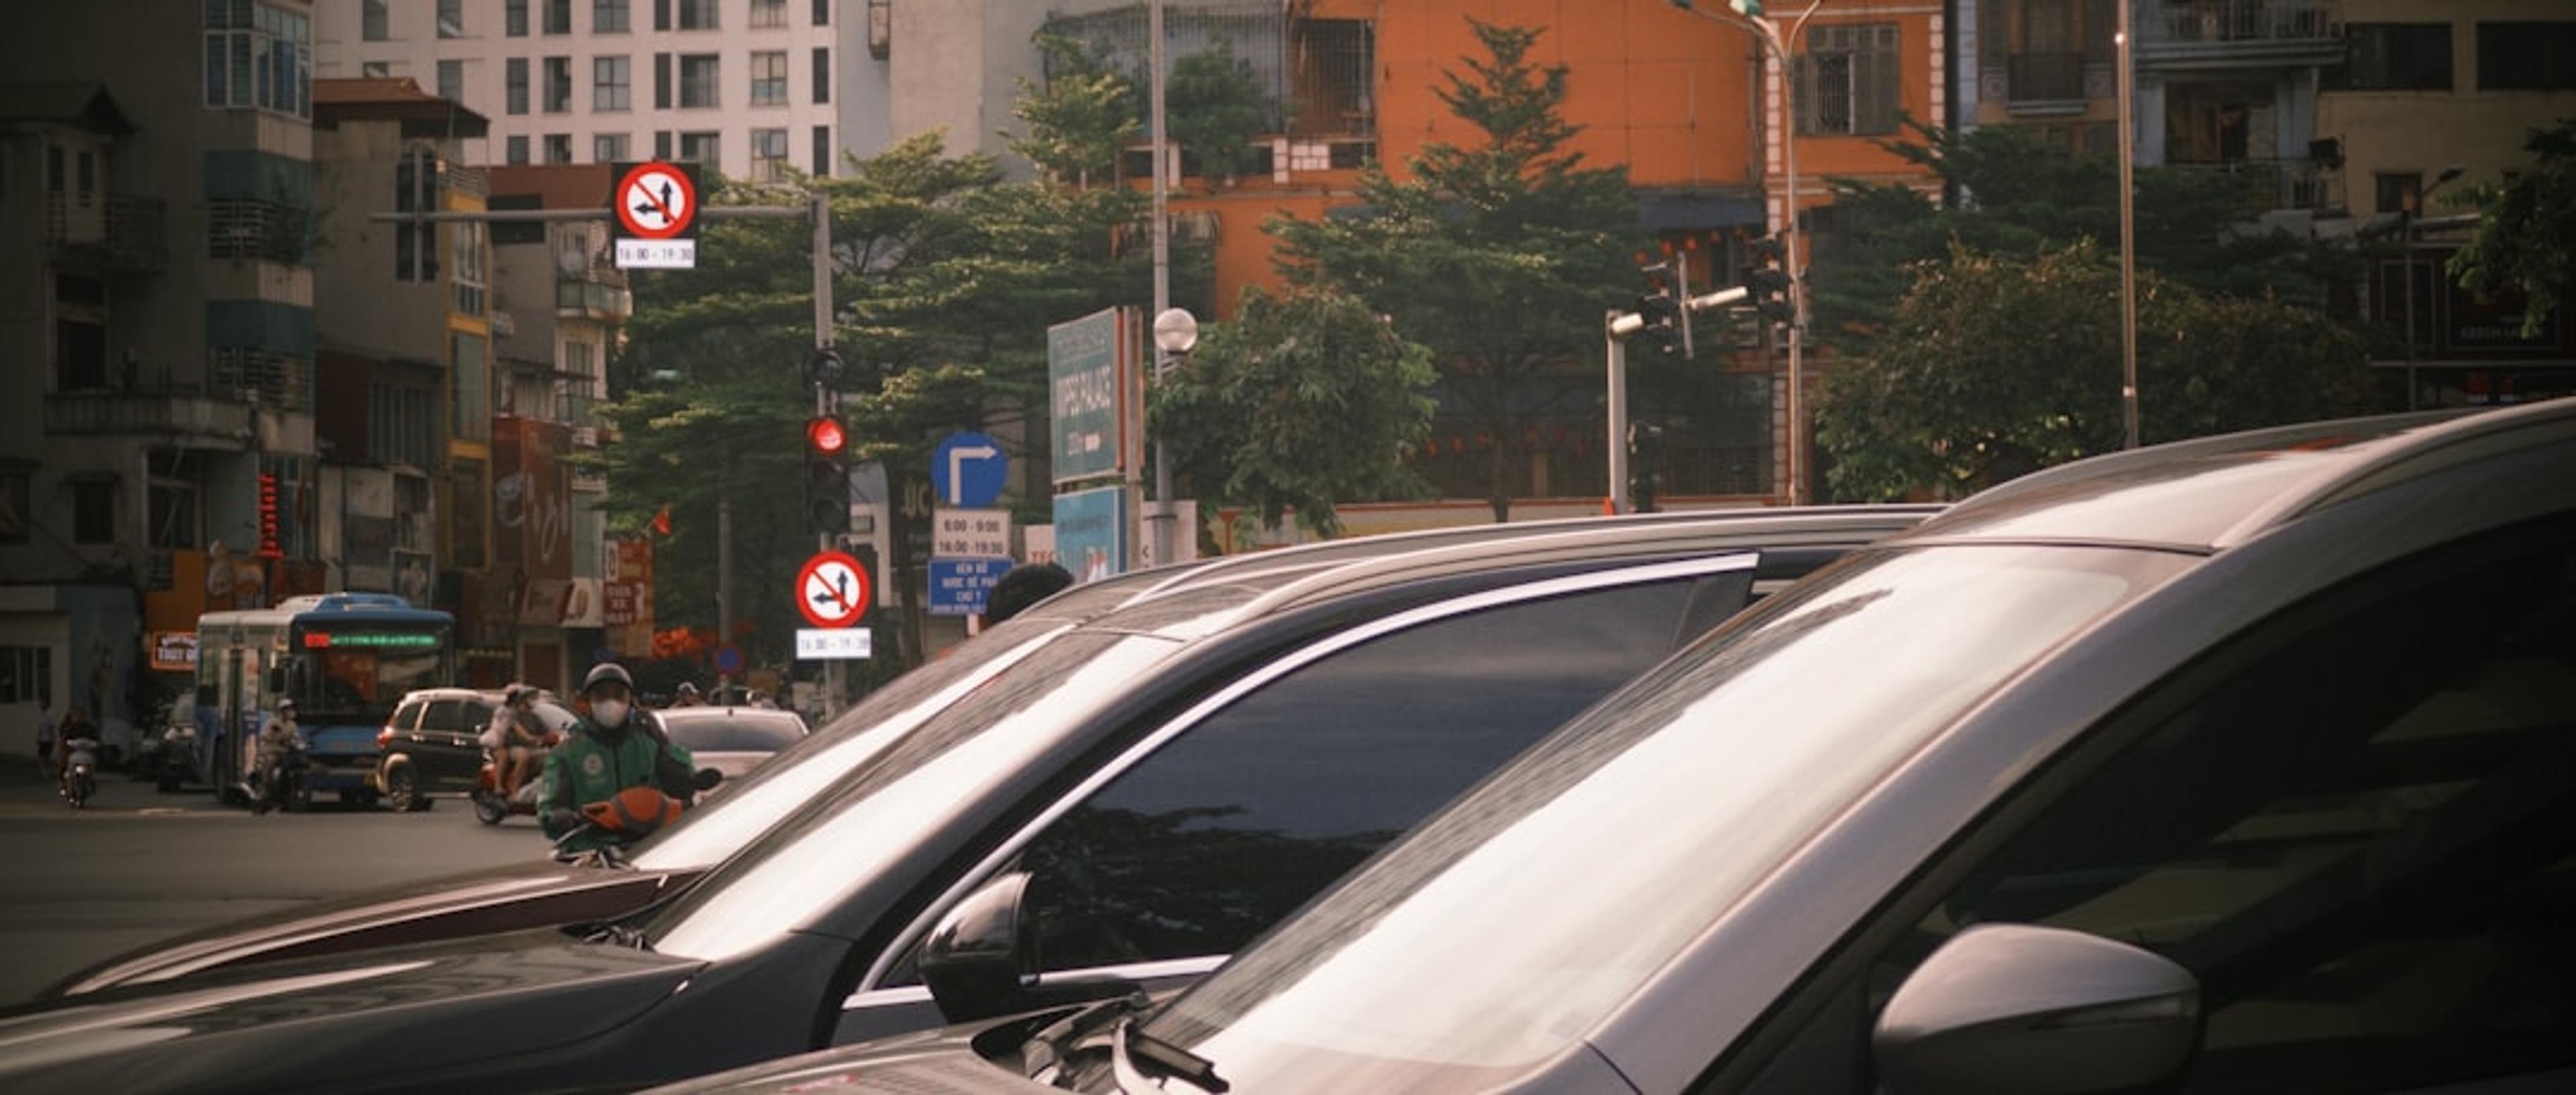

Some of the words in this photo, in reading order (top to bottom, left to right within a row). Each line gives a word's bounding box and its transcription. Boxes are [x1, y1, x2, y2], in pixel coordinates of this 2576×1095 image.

[944, 519, 967, 533] 6:00
[976, 519, 1000, 533] 9:00
[939, 539, 967, 553] 16:00
[975, 541, 1004, 554] 19:30
